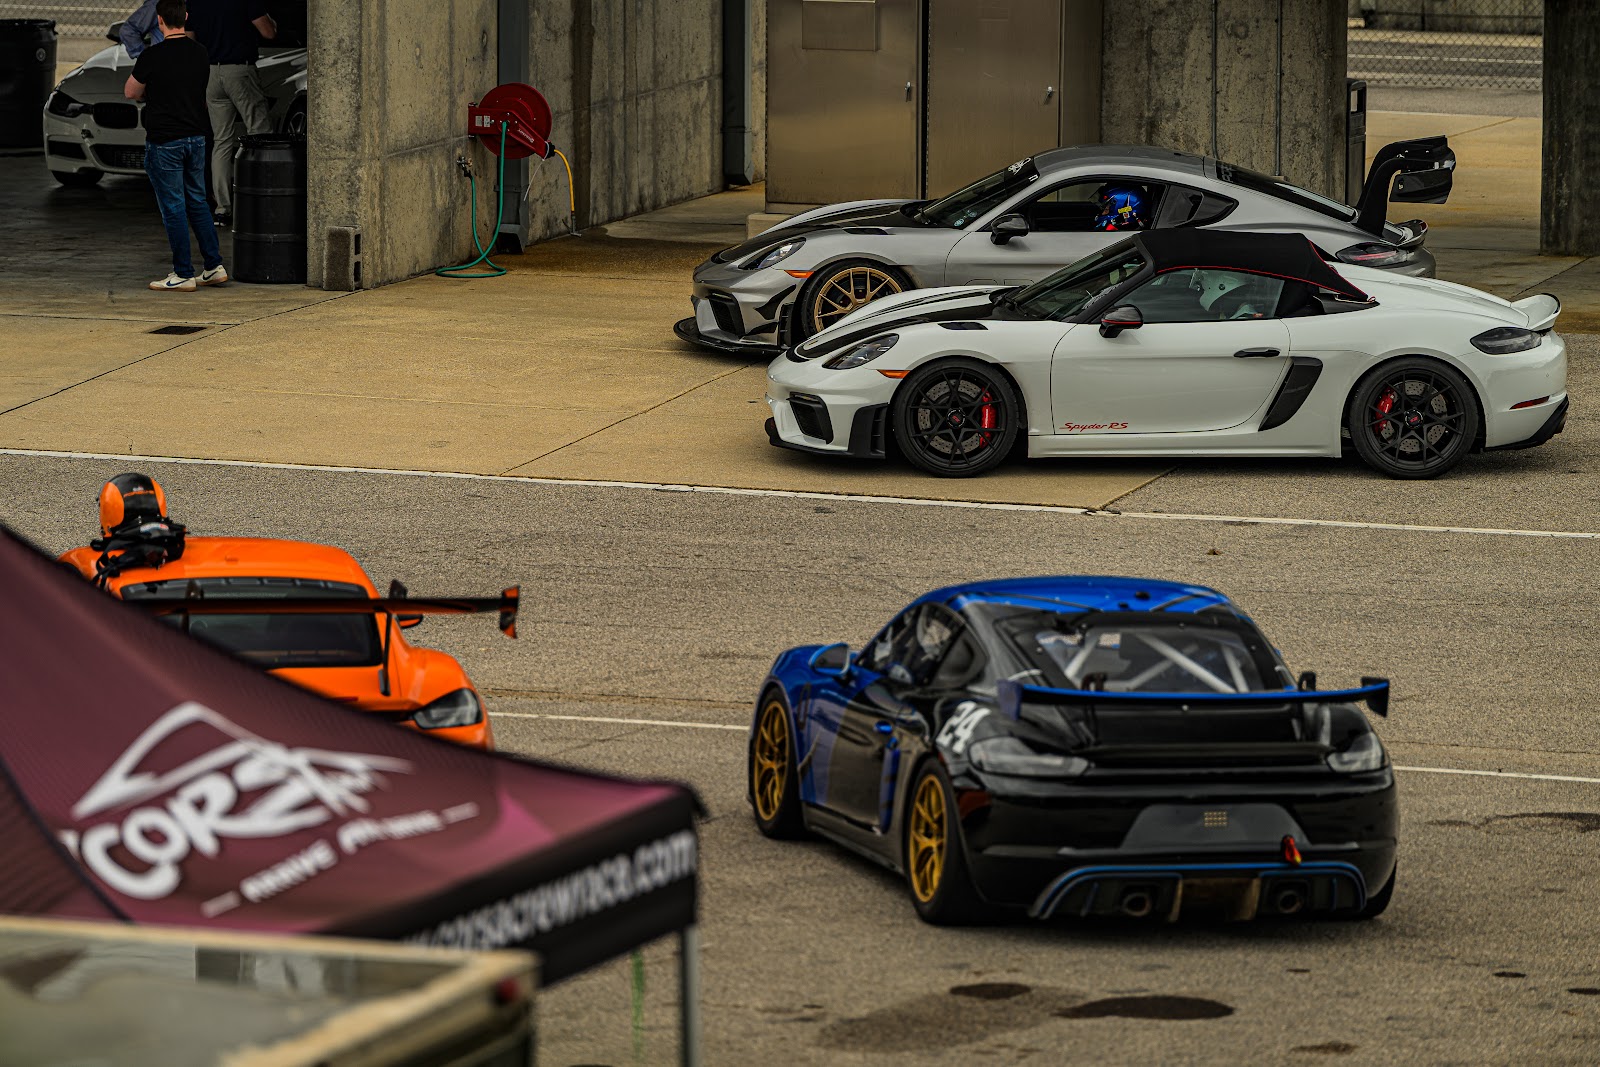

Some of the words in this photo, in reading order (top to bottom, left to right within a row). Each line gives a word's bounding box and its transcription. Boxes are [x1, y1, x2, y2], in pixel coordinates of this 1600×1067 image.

[1059, 422, 1107, 432] Spyder
[1108, 422, 1129, 430] RS
[935, 700, 992, 754] 24
